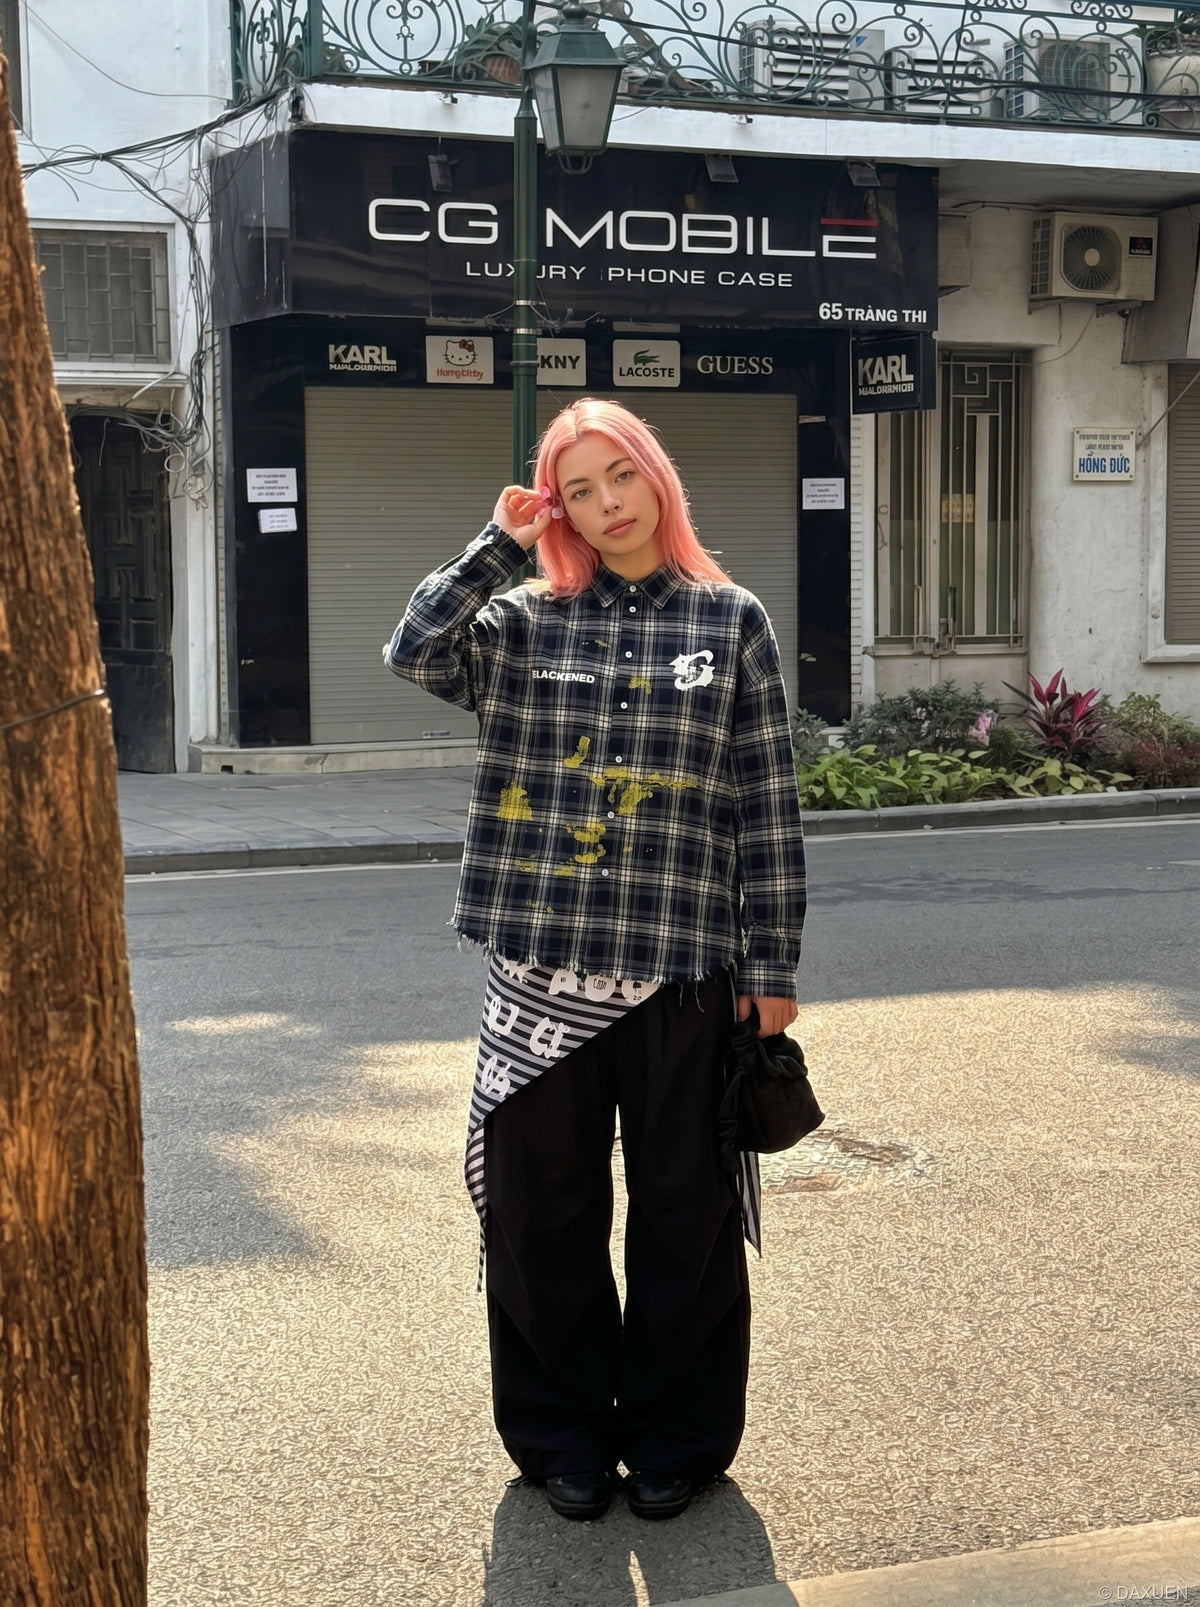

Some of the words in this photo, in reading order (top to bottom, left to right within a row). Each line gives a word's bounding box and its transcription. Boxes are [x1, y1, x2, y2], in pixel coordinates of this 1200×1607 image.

[368, 198, 498, 244] CG
[545, 207, 878, 259] MOBILE
[608, 267, 705, 285] PHONE
[718, 271, 793, 287] CASE
[818, 302, 843, 320] 65
[845, 305, 898, 322] TRÀNG
[902, 309, 927, 323] THI
[328, 344, 397, 365] KARL
[536, 355, 581, 369] KNY
[619, 366, 675, 378] LACOSTE
[697, 355, 774, 375] GUESS
[858, 354, 914, 386] KARL
[1109, 453, 1130, 473] ĐỨC
